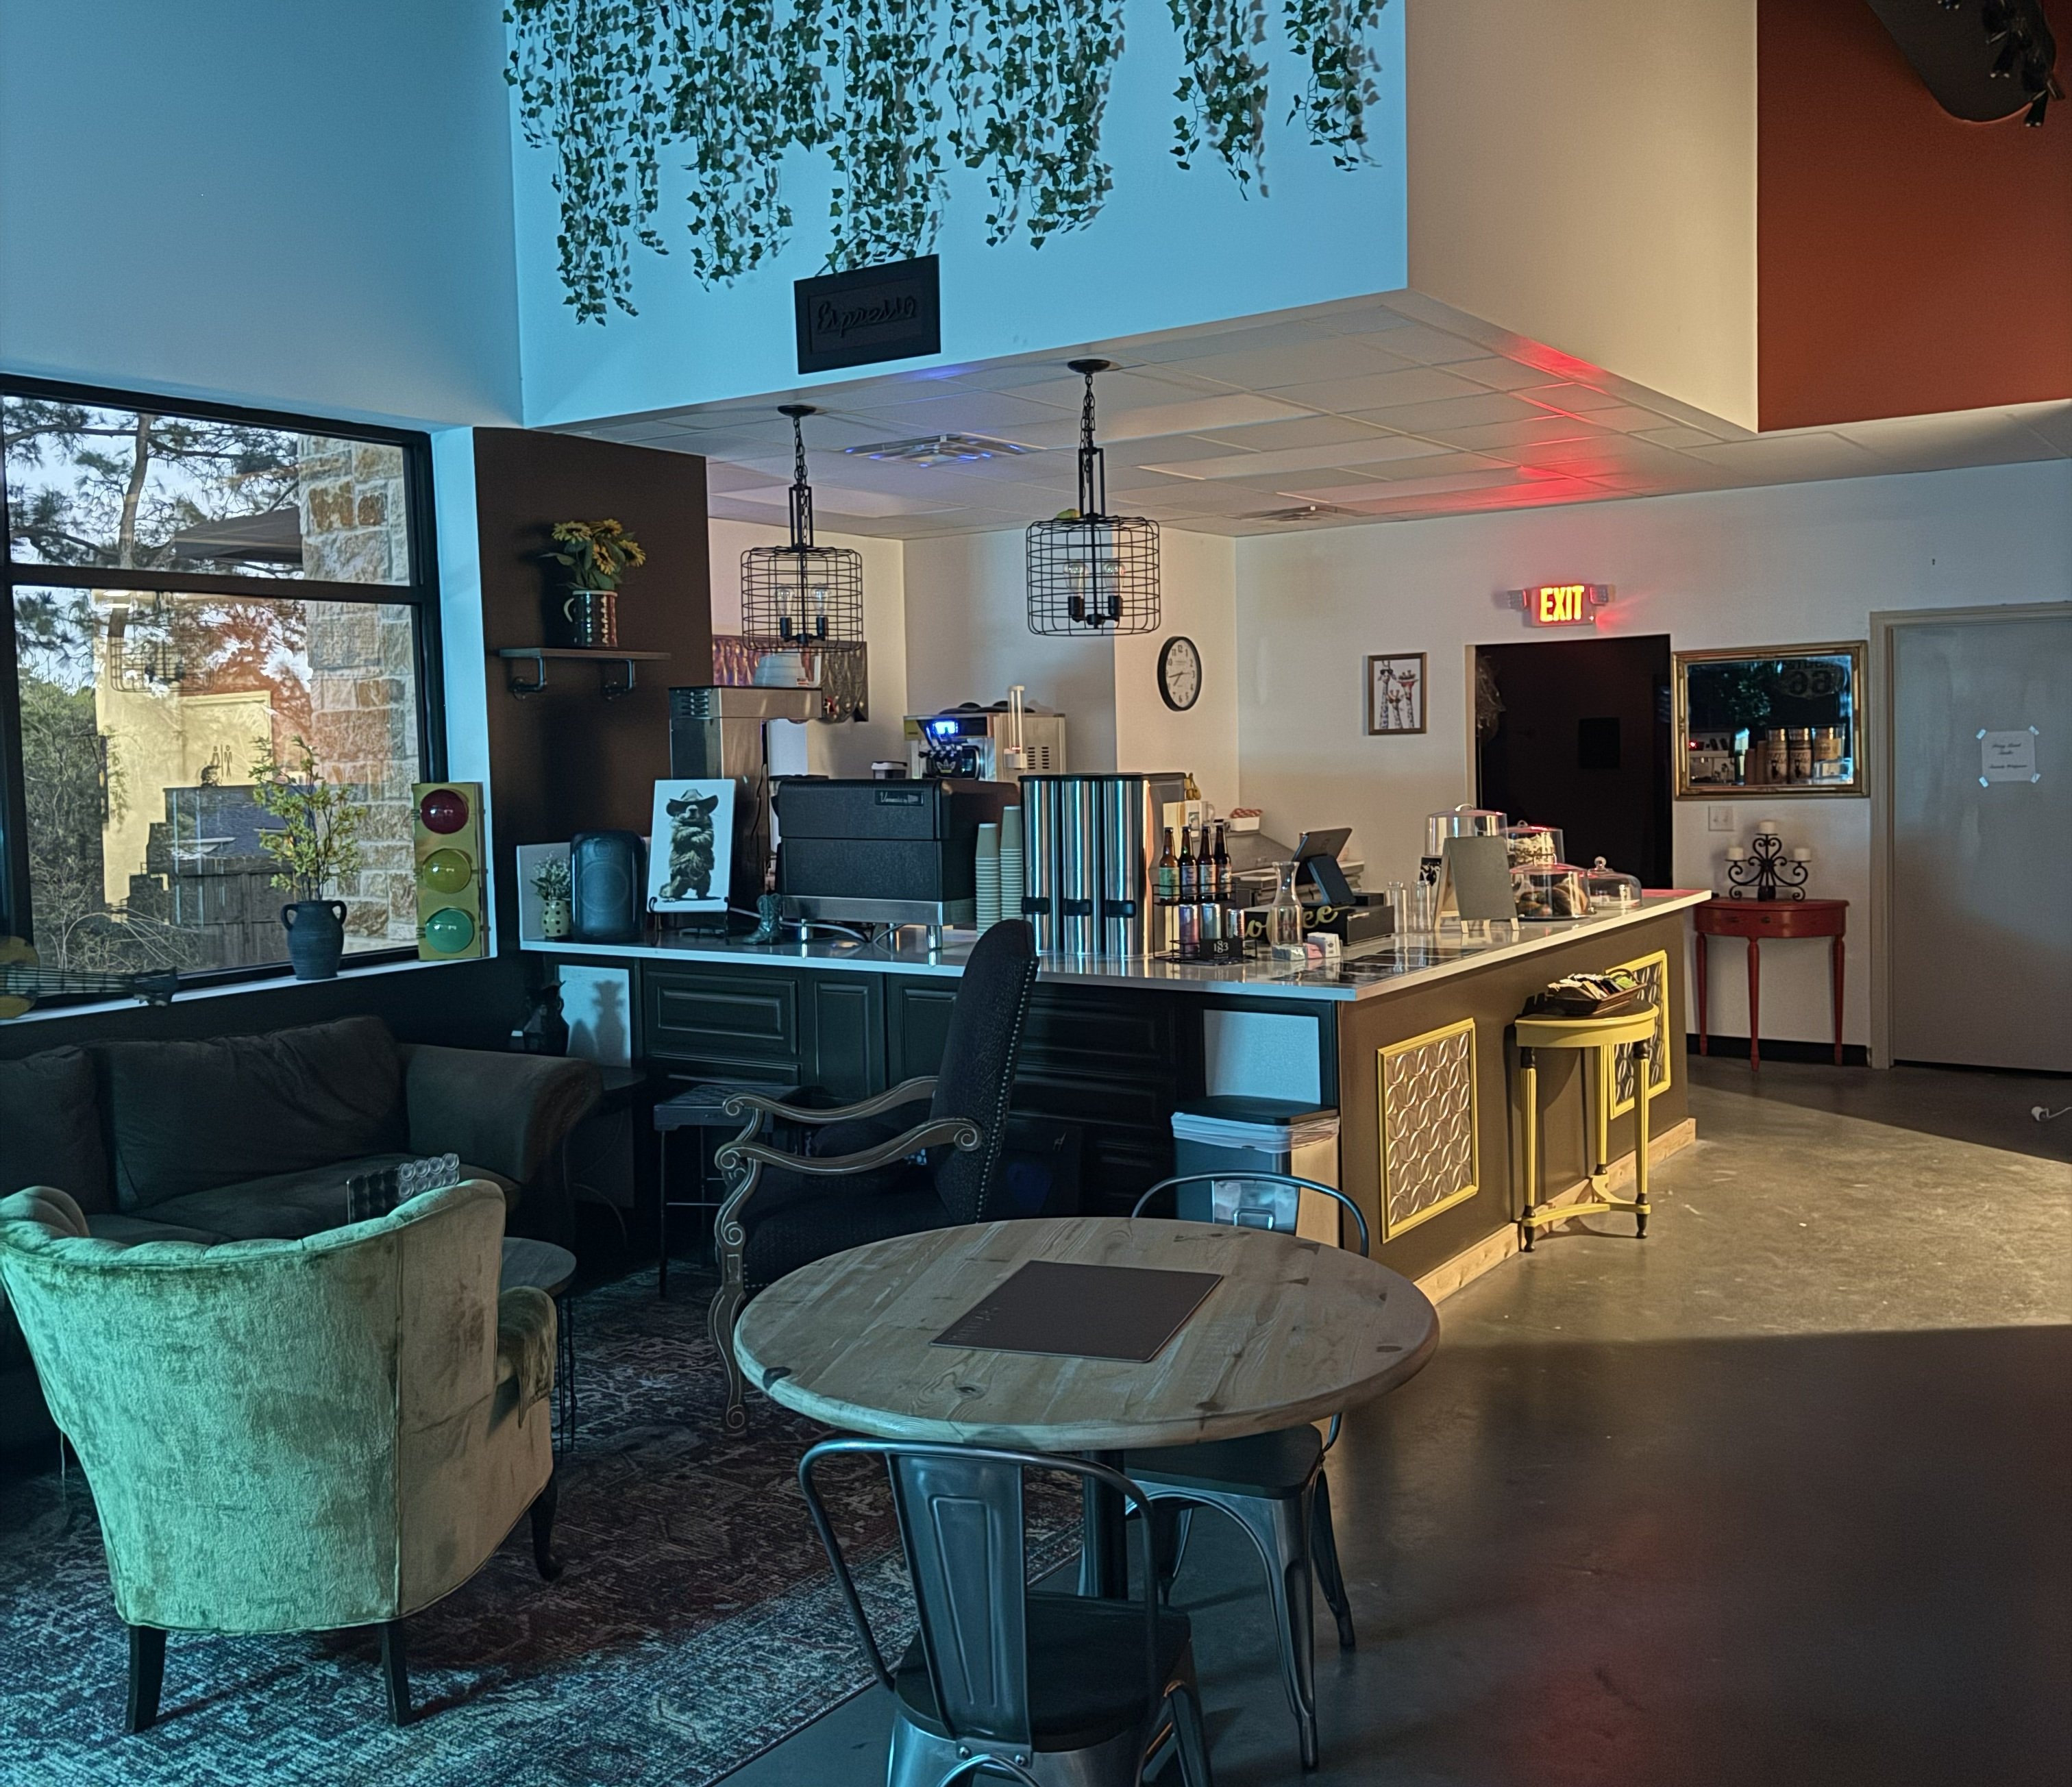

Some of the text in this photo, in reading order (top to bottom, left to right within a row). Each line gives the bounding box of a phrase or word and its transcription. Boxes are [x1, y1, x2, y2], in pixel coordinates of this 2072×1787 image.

[817, 295, 917, 338] Espresso
[1540, 585, 1585, 622] EXIT
[1244, 905, 1338, 944] oee
[1213, 940, 1229, 953] 1883
